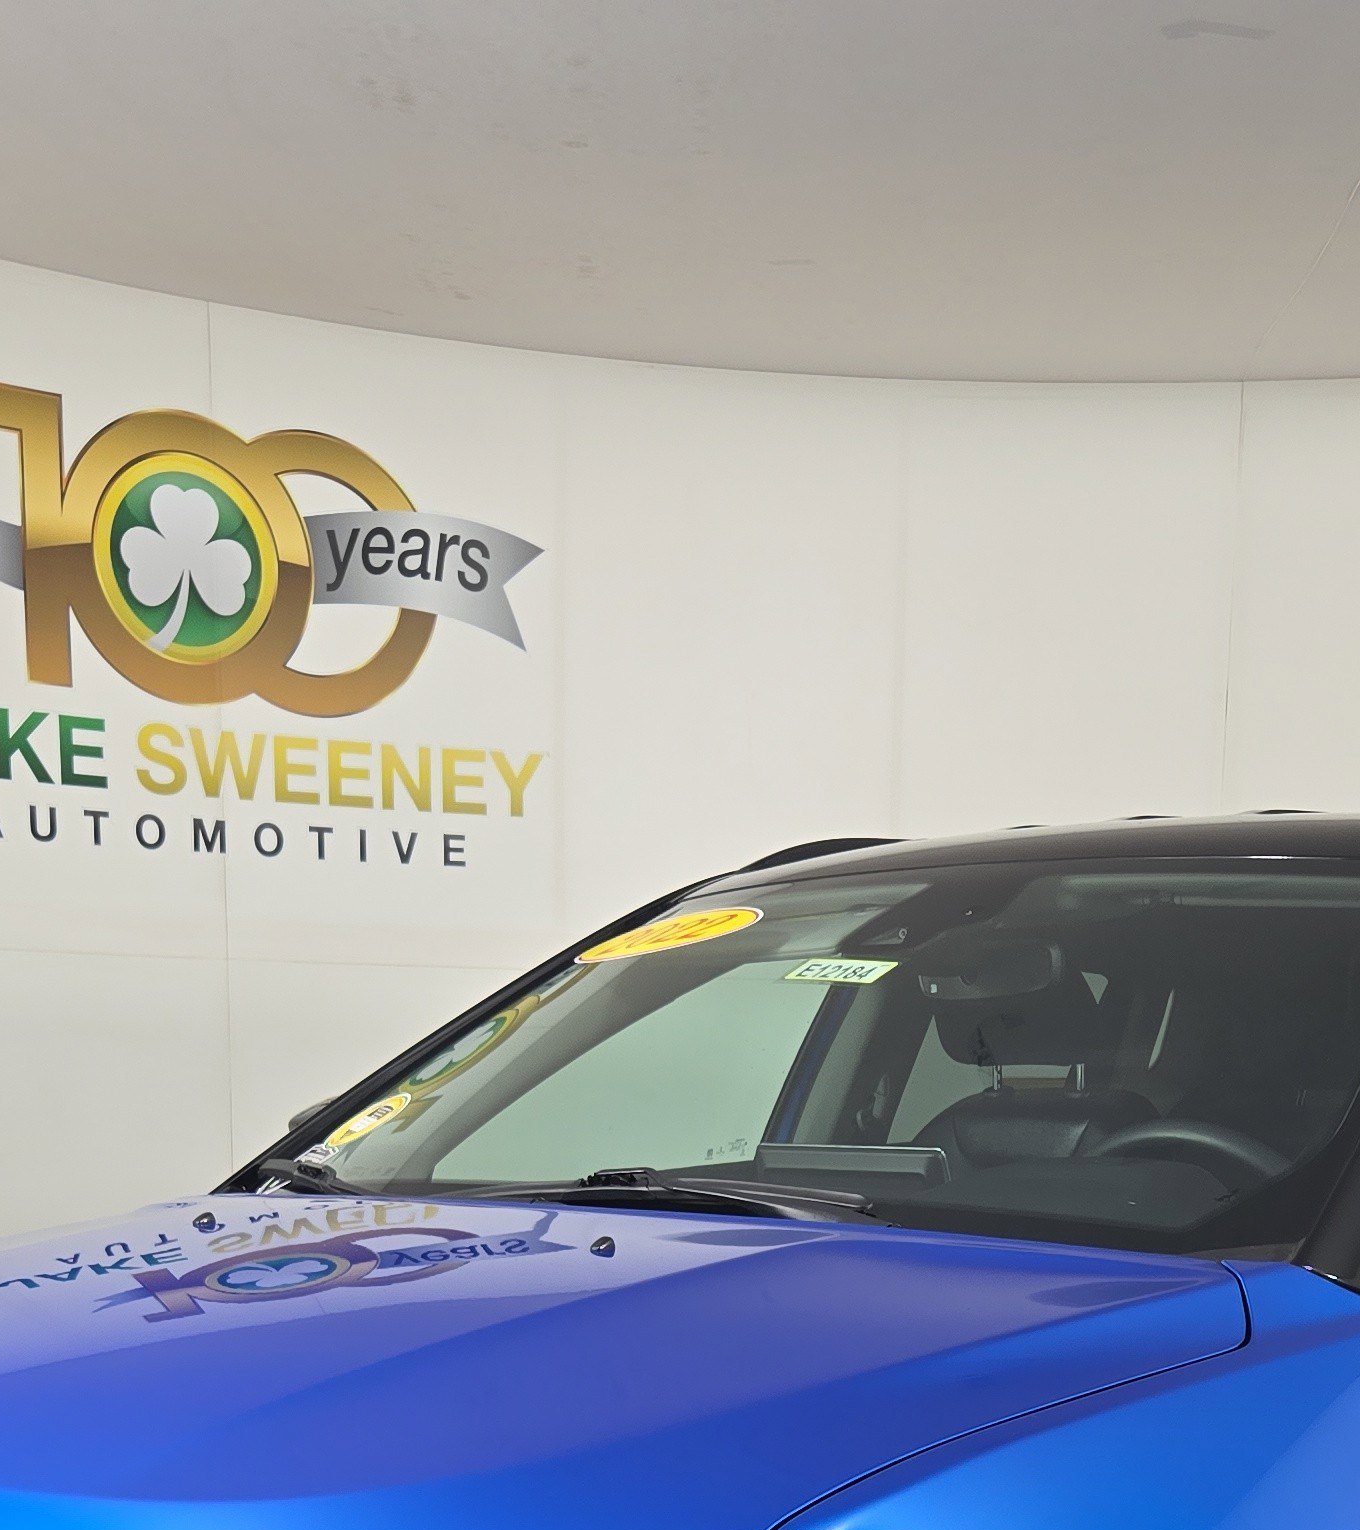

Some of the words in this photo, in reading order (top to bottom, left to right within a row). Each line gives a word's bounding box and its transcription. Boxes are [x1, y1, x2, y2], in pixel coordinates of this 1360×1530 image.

[325, 523, 492, 592] years
[135, 722, 544, 818] SWEENEY
[795, 962, 877, 981] E12184
